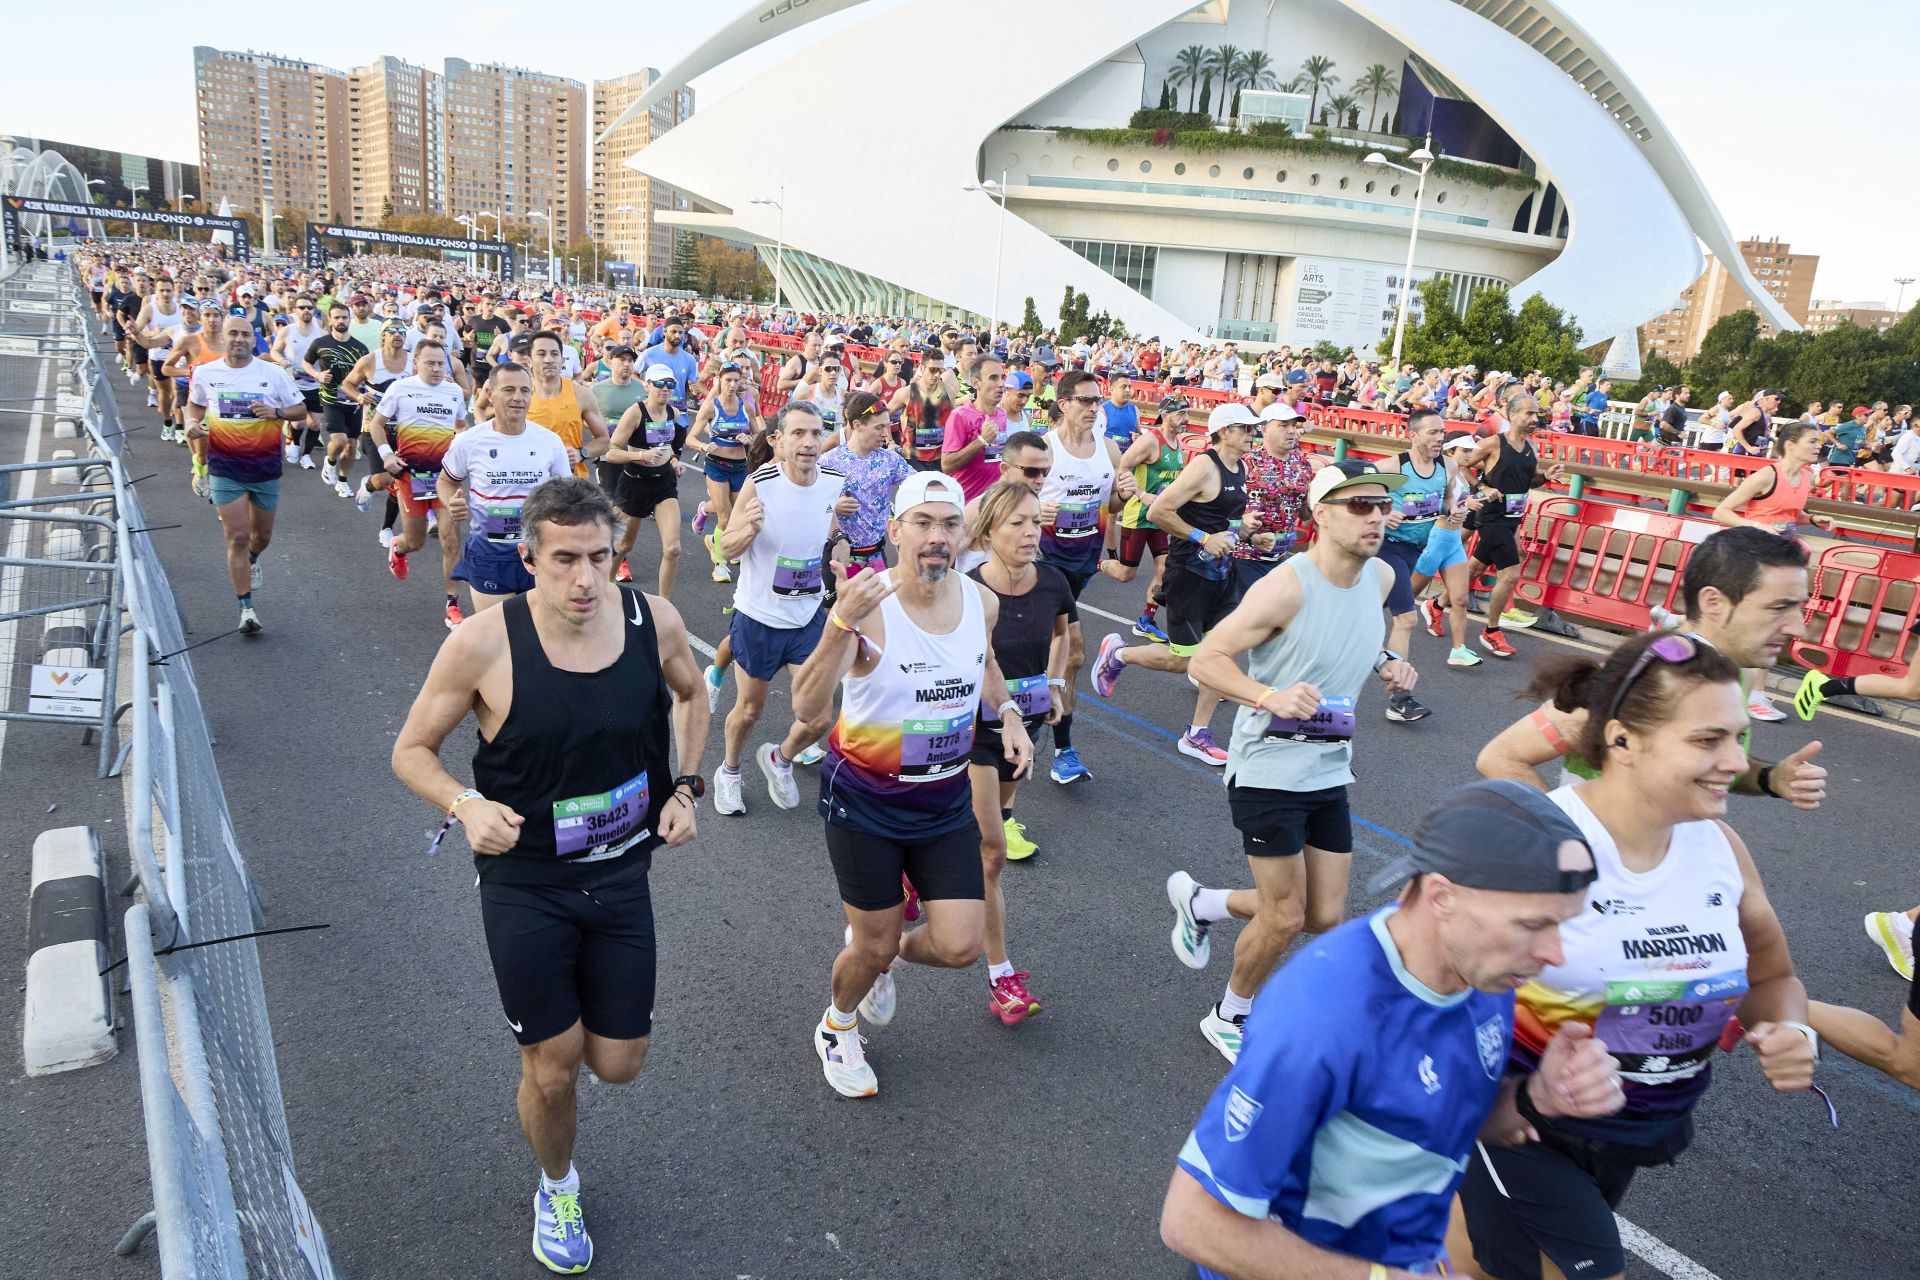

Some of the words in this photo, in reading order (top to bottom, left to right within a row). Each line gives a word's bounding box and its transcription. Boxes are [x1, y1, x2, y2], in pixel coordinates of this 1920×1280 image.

[24, 200, 43, 211] 42K
[44, 202, 88, 215] VALENCIA
[87, 207, 141, 220] TRINIDAD
[141, 212, 192, 225] ALFONSO
[205, 219, 231, 227] ZURICH
[327, 227, 343, 236] 42K
[344, 228, 380, 240] VALENCIA
[380, 232, 424, 245] TRINIDAD
[424, 237, 468, 249] ALFONSO
[1304, 264, 1319, 273] LES
[1302, 273, 1324, 283] ARTS
[416, 406, 453, 416] MARATHON
[1066, 488, 1101, 497] MARATHON
[934, 678, 962, 687] VALENCIA
[915, 682, 975, 702] MARATHON
[1297, 712, 1333, 724] 444
[587, 802, 629, 831] 36423
[585, 820, 631, 846] Almeida
[1645, 924, 1689, 936] VALENCIA
[1622, 932, 1728, 960] MARATHON
[1648, 1005, 1704, 1026] 5000
